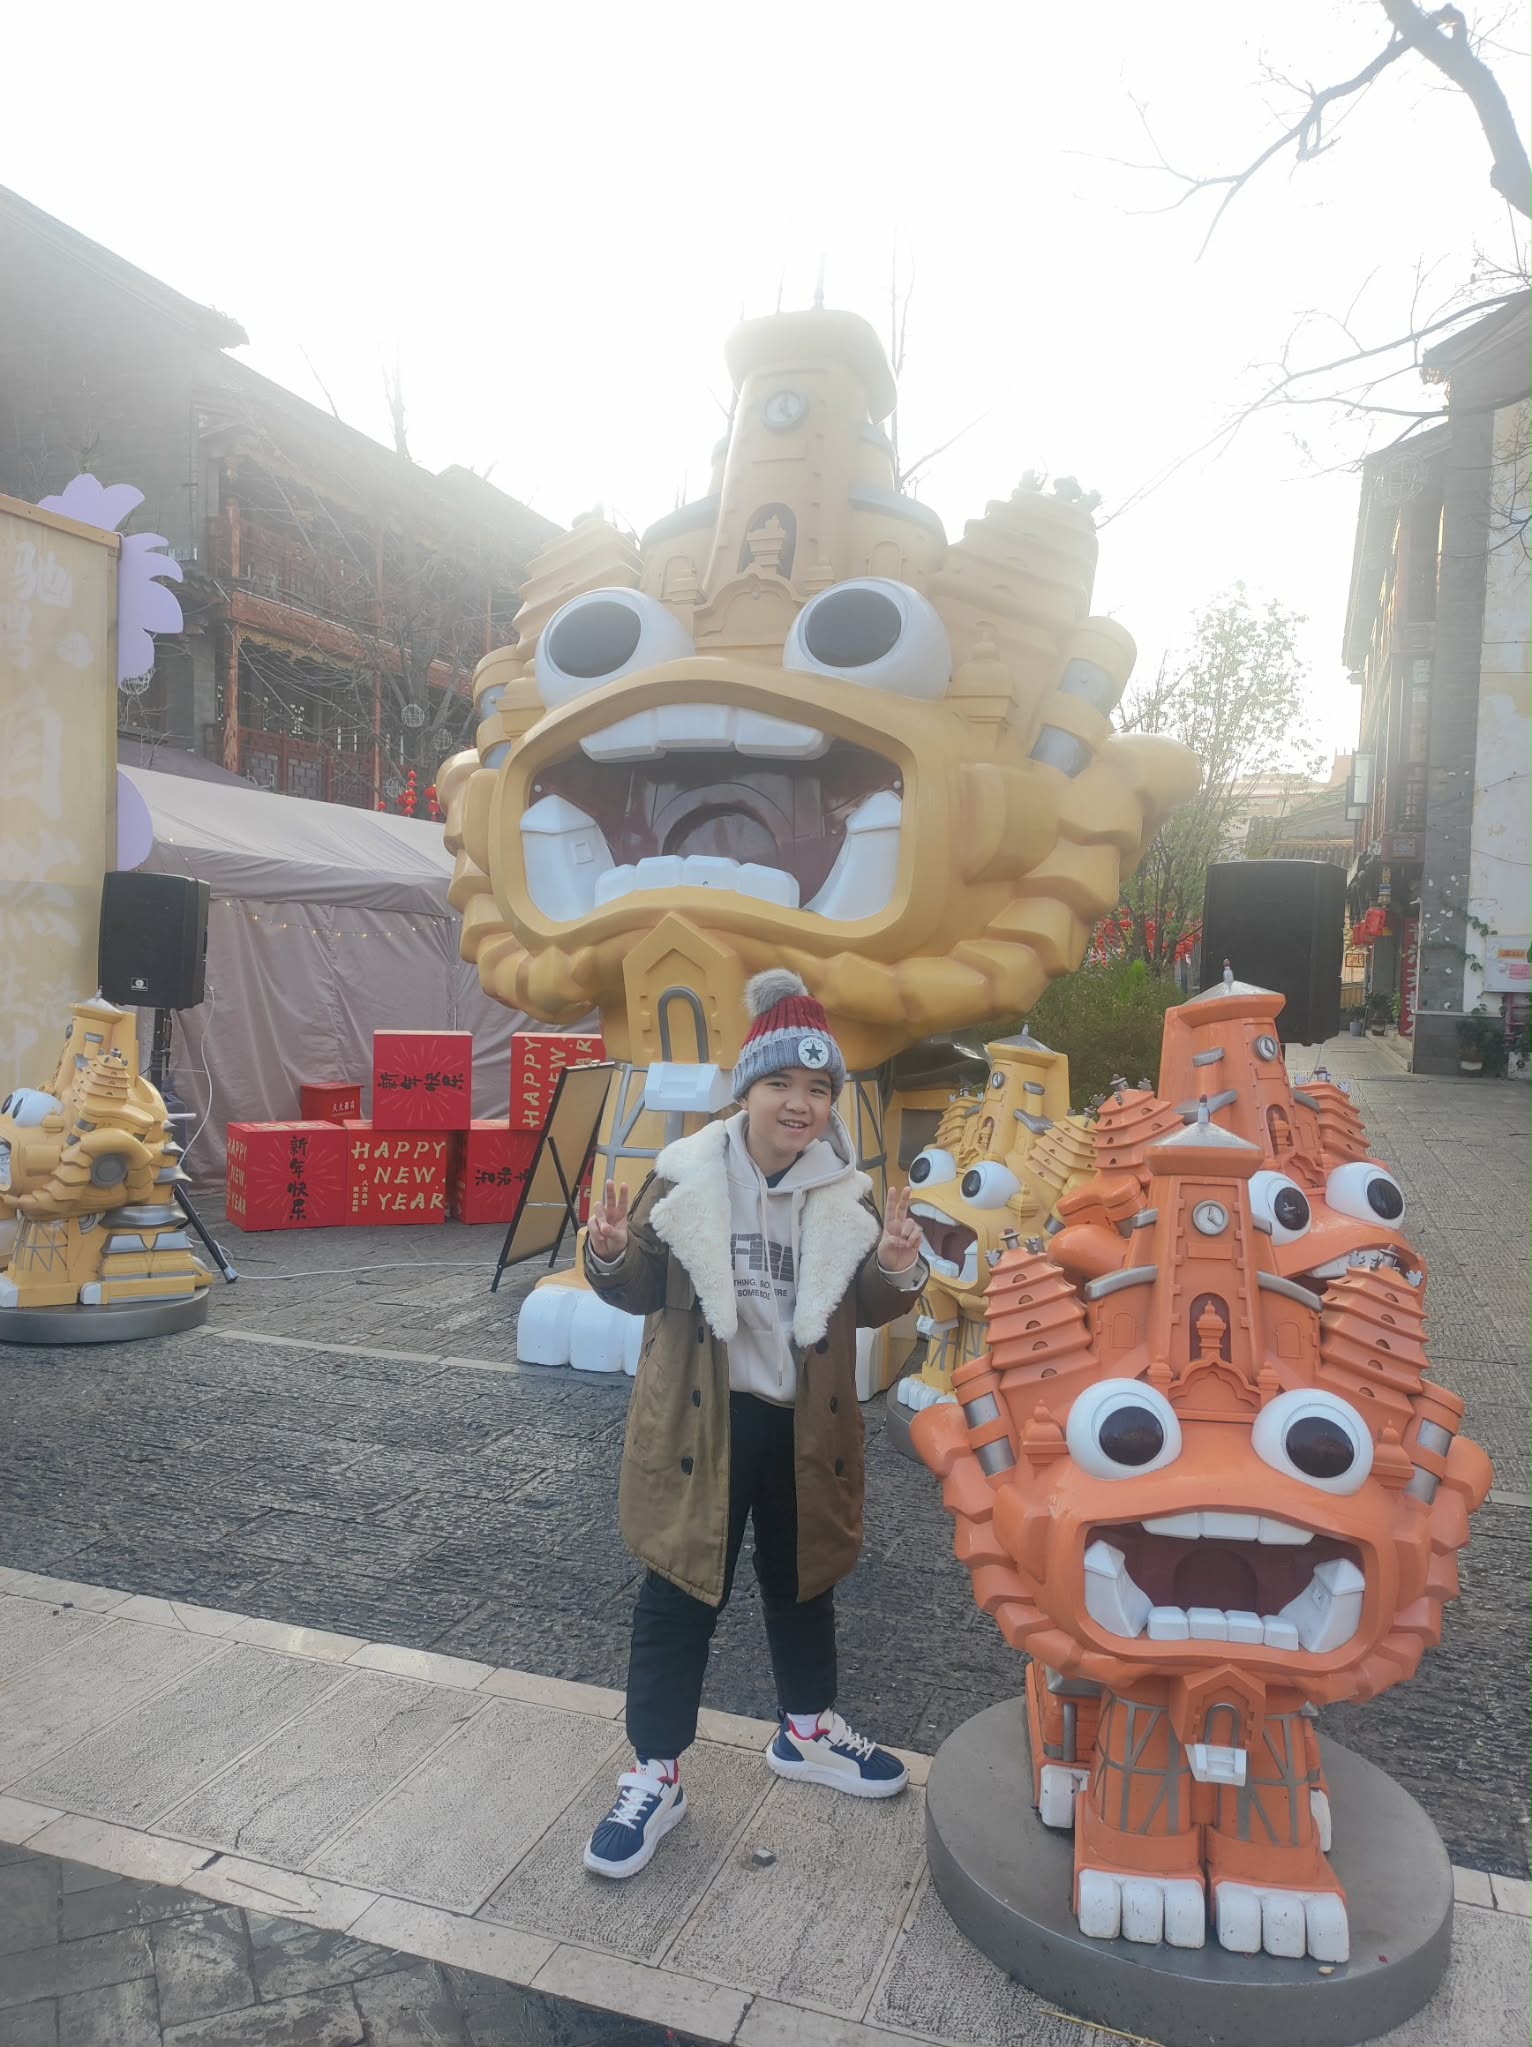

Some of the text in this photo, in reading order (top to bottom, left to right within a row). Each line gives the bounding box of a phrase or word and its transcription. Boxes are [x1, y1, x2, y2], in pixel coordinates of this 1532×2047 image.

[377, 1071, 464, 1092] 新年快乐
[522, 1037, 542, 1128] HAPPY
[351, 1141, 447, 1159] HAPPY
[287, 1135, 309, 1221] 新年快乐
[373, 1166, 436, 1184] NEW
[378, 1191, 444, 1211] YEAR
